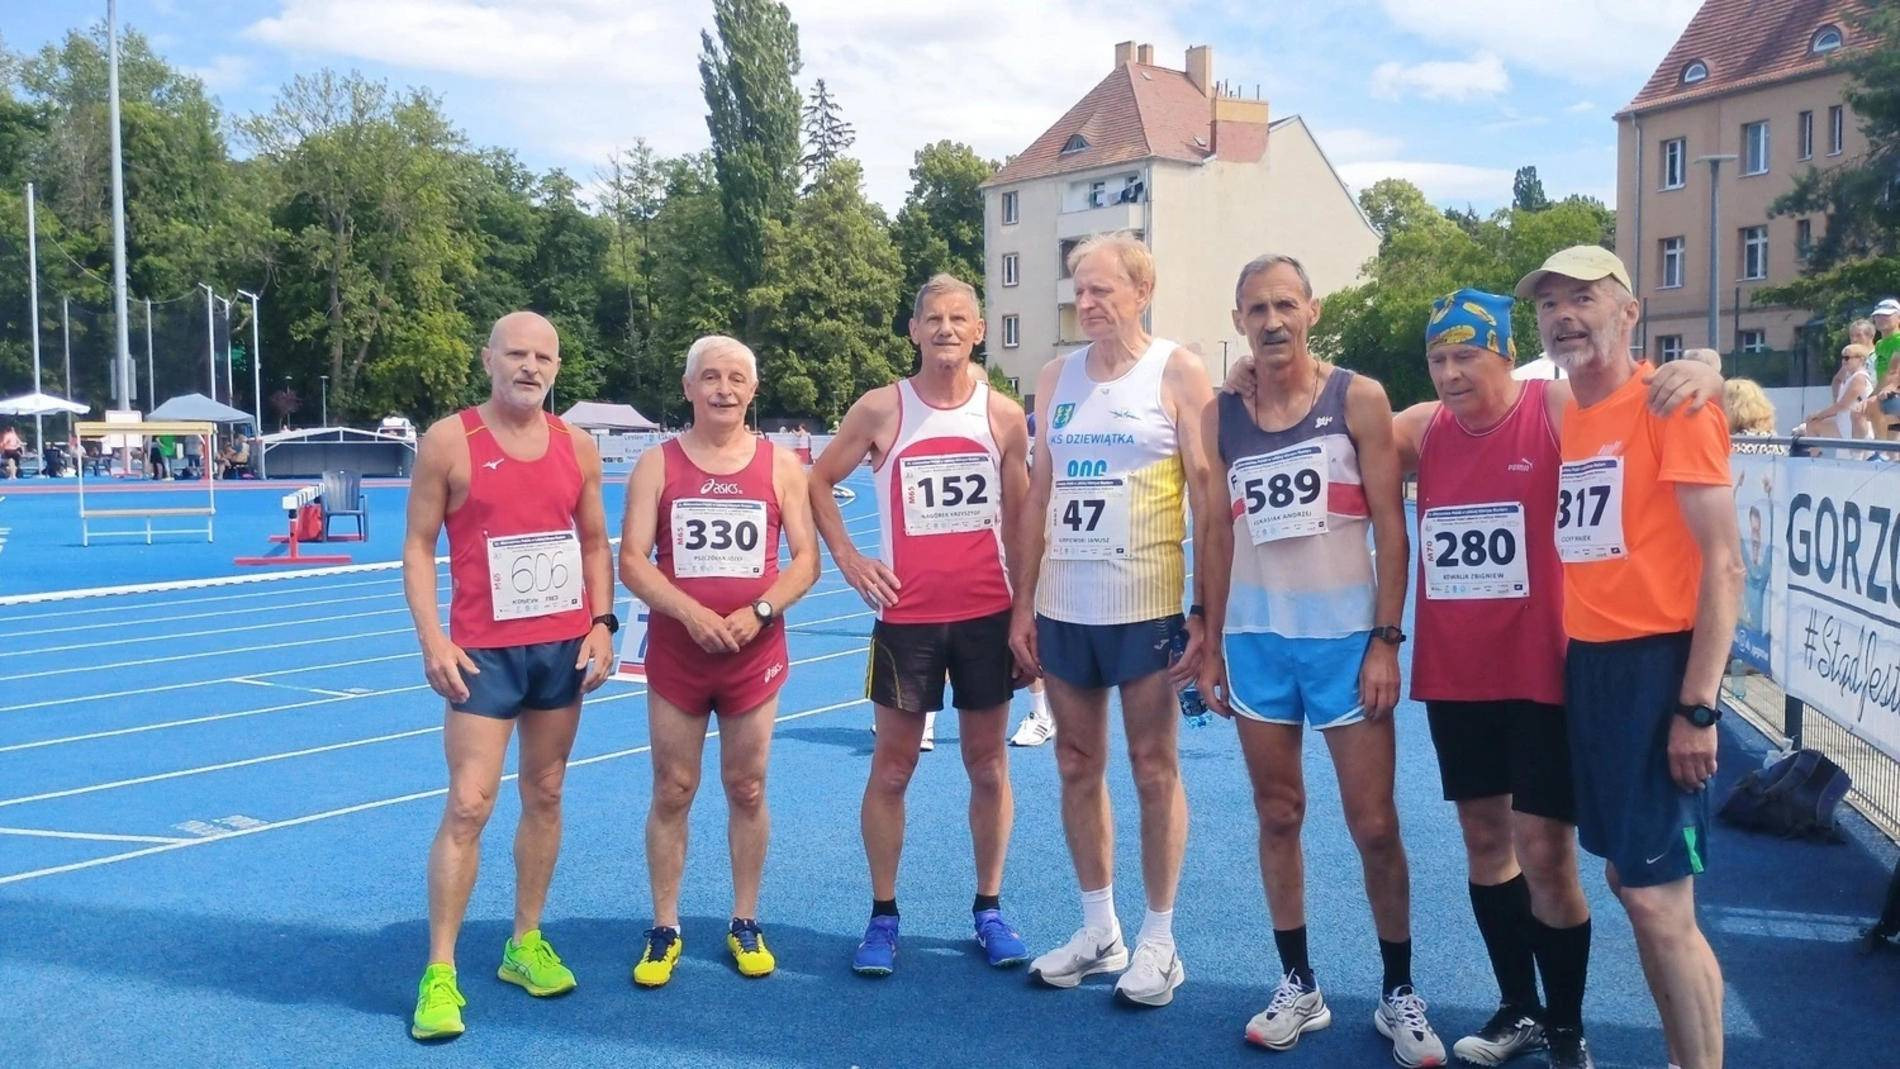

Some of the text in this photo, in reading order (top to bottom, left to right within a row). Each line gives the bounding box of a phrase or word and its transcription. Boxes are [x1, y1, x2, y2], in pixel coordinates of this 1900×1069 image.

[1066, 433, 1135, 446] DZIEWIĄTKA
[917, 473, 988, 508] 152
[1245, 468, 1321, 515] 589
[1558, 485, 1611, 529] 317
[1063, 499, 1106, 531] 47
[685, 519, 758, 551] 330
[1426, 541, 1434, 562] M70
[1434, 528, 1516, 568] 280
[511, 550, 569, 594] 606
